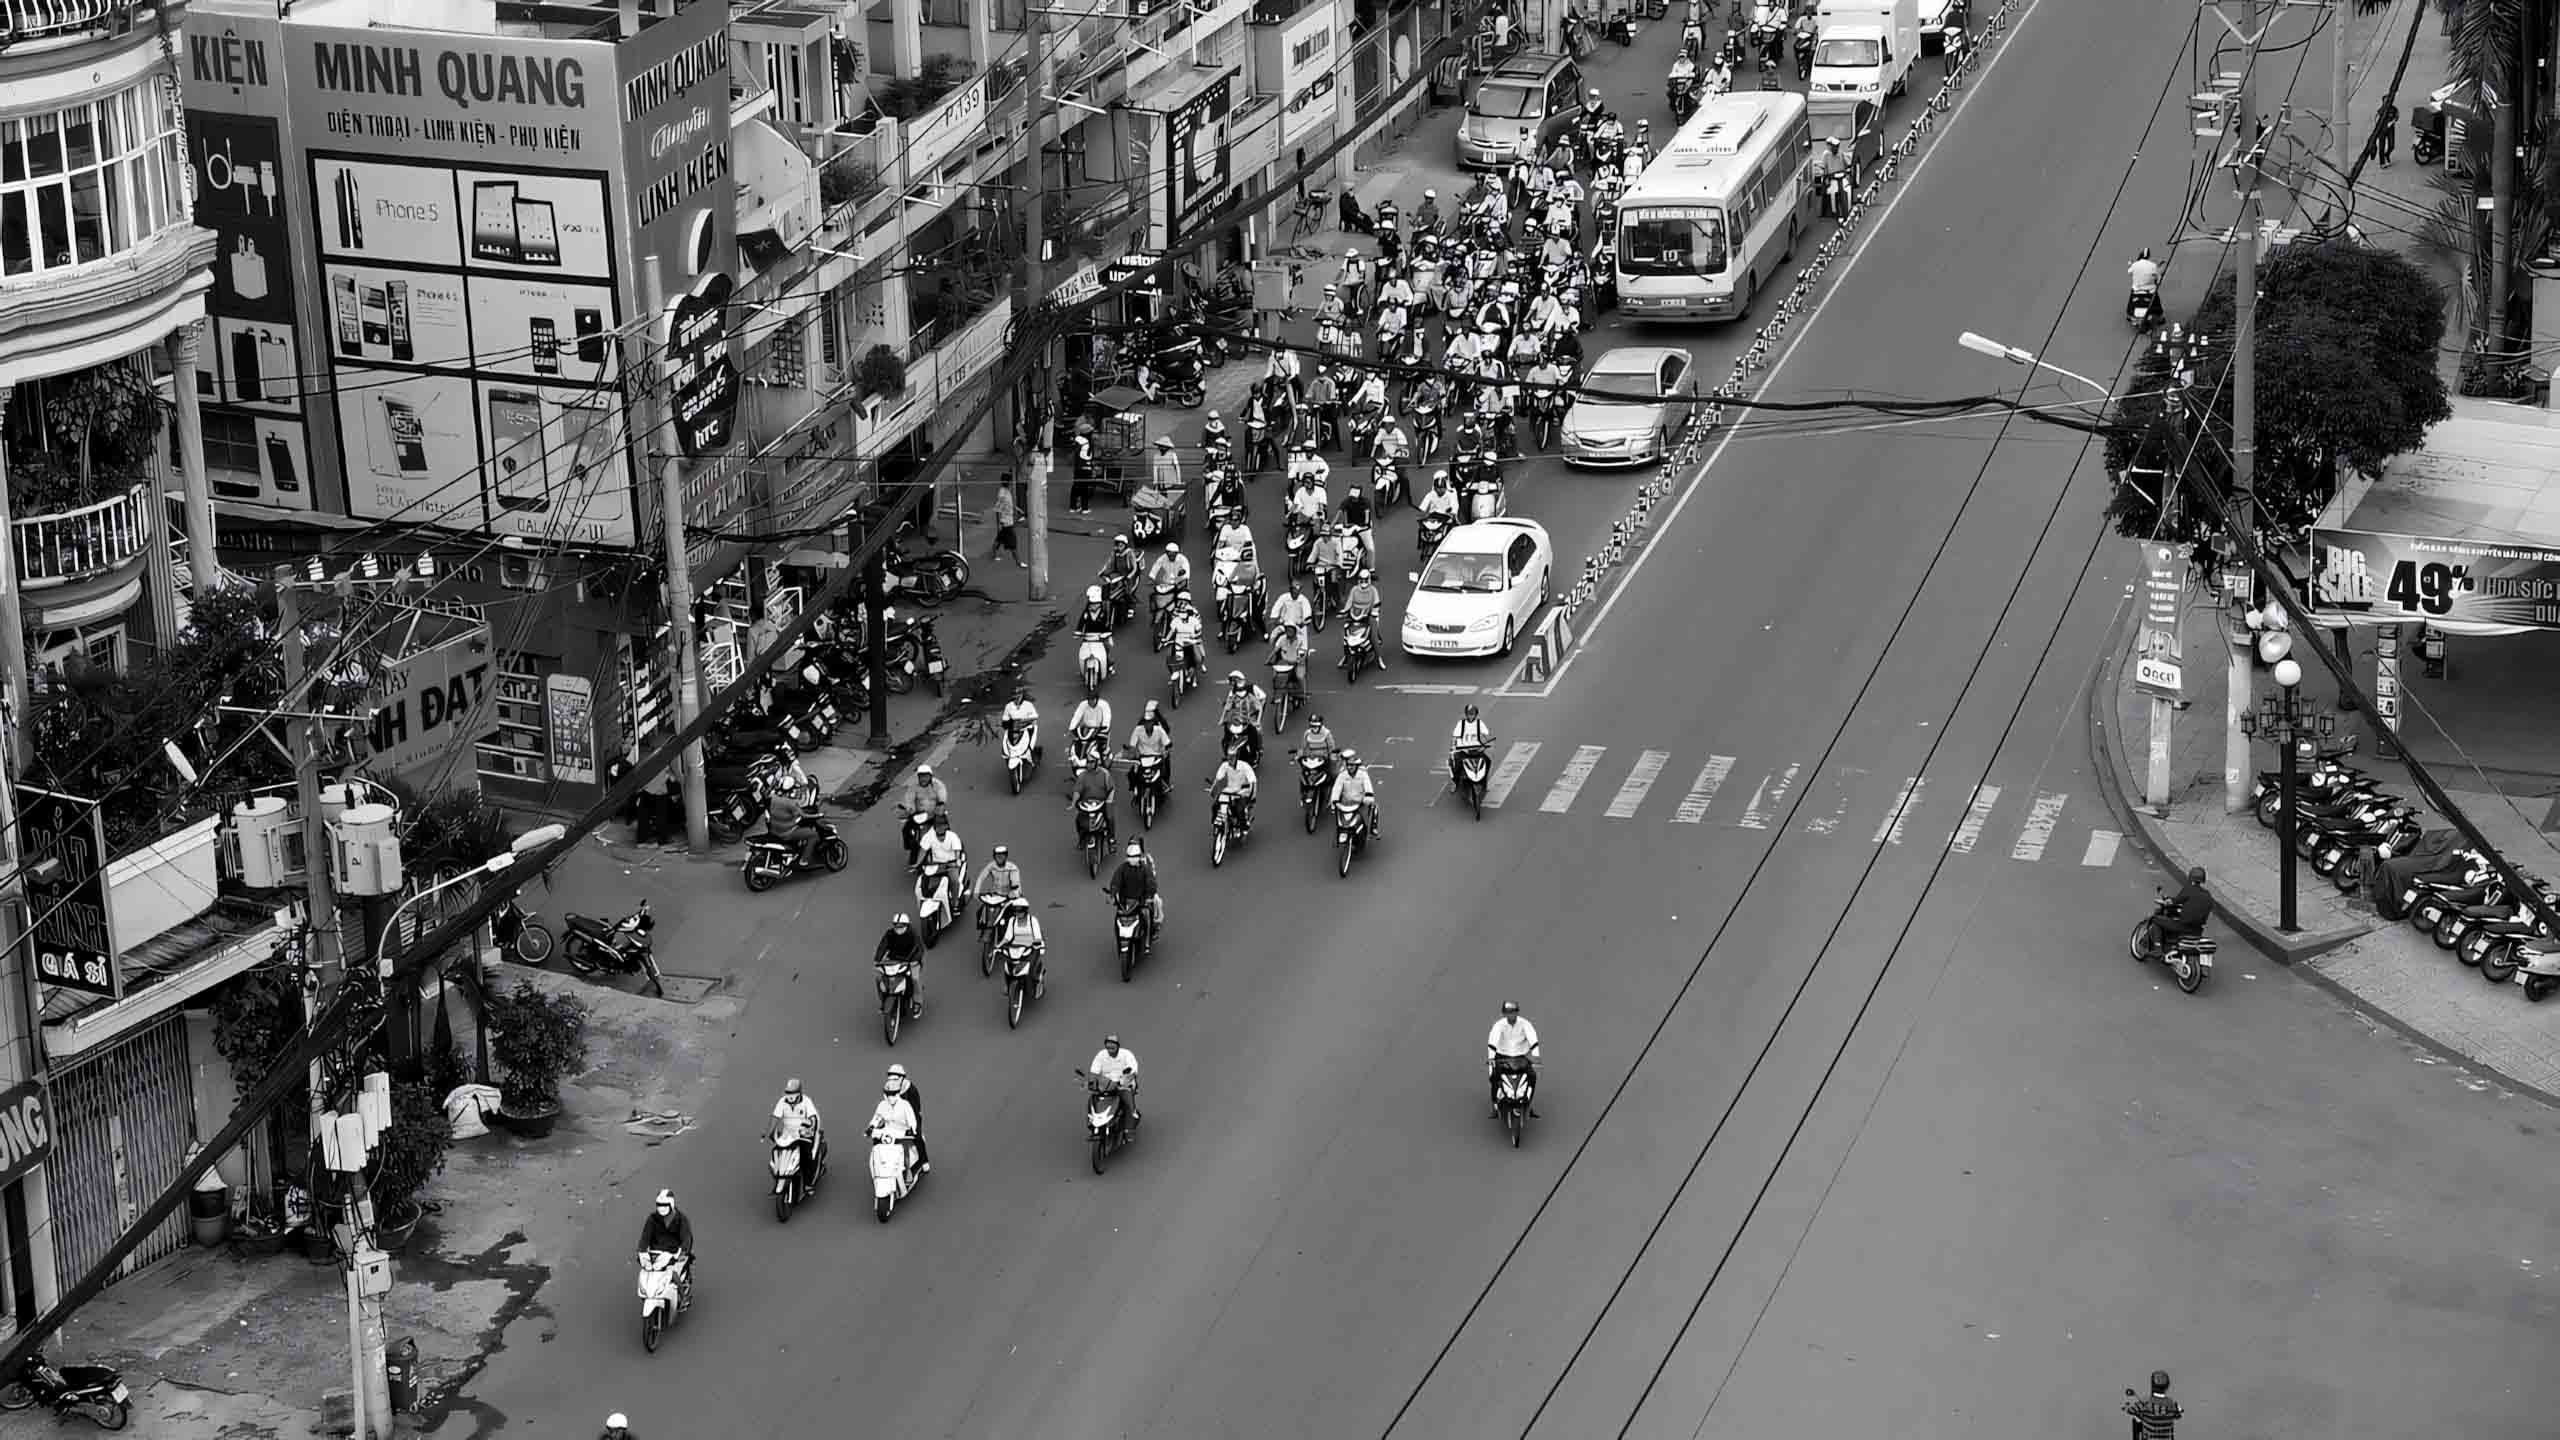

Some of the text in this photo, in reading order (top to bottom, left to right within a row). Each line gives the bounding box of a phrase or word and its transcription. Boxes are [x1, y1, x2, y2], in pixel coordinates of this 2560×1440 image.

[191, 29, 269, 96] KIỆN
[314, 41, 585, 109] MINH QUANG
[625, 62, 669, 123] MINH
[367, 113, 411, 142] THOẠI
[424, 117, 456, 141] LINH
[509, 124, 538, 152] PHỤ
[430, 203, 439, 222] 5
[637, 171, 680, 230] LINH
[2327, 545, 2367, 576] BIG
[2387, 560, 2474, 614] 49%
